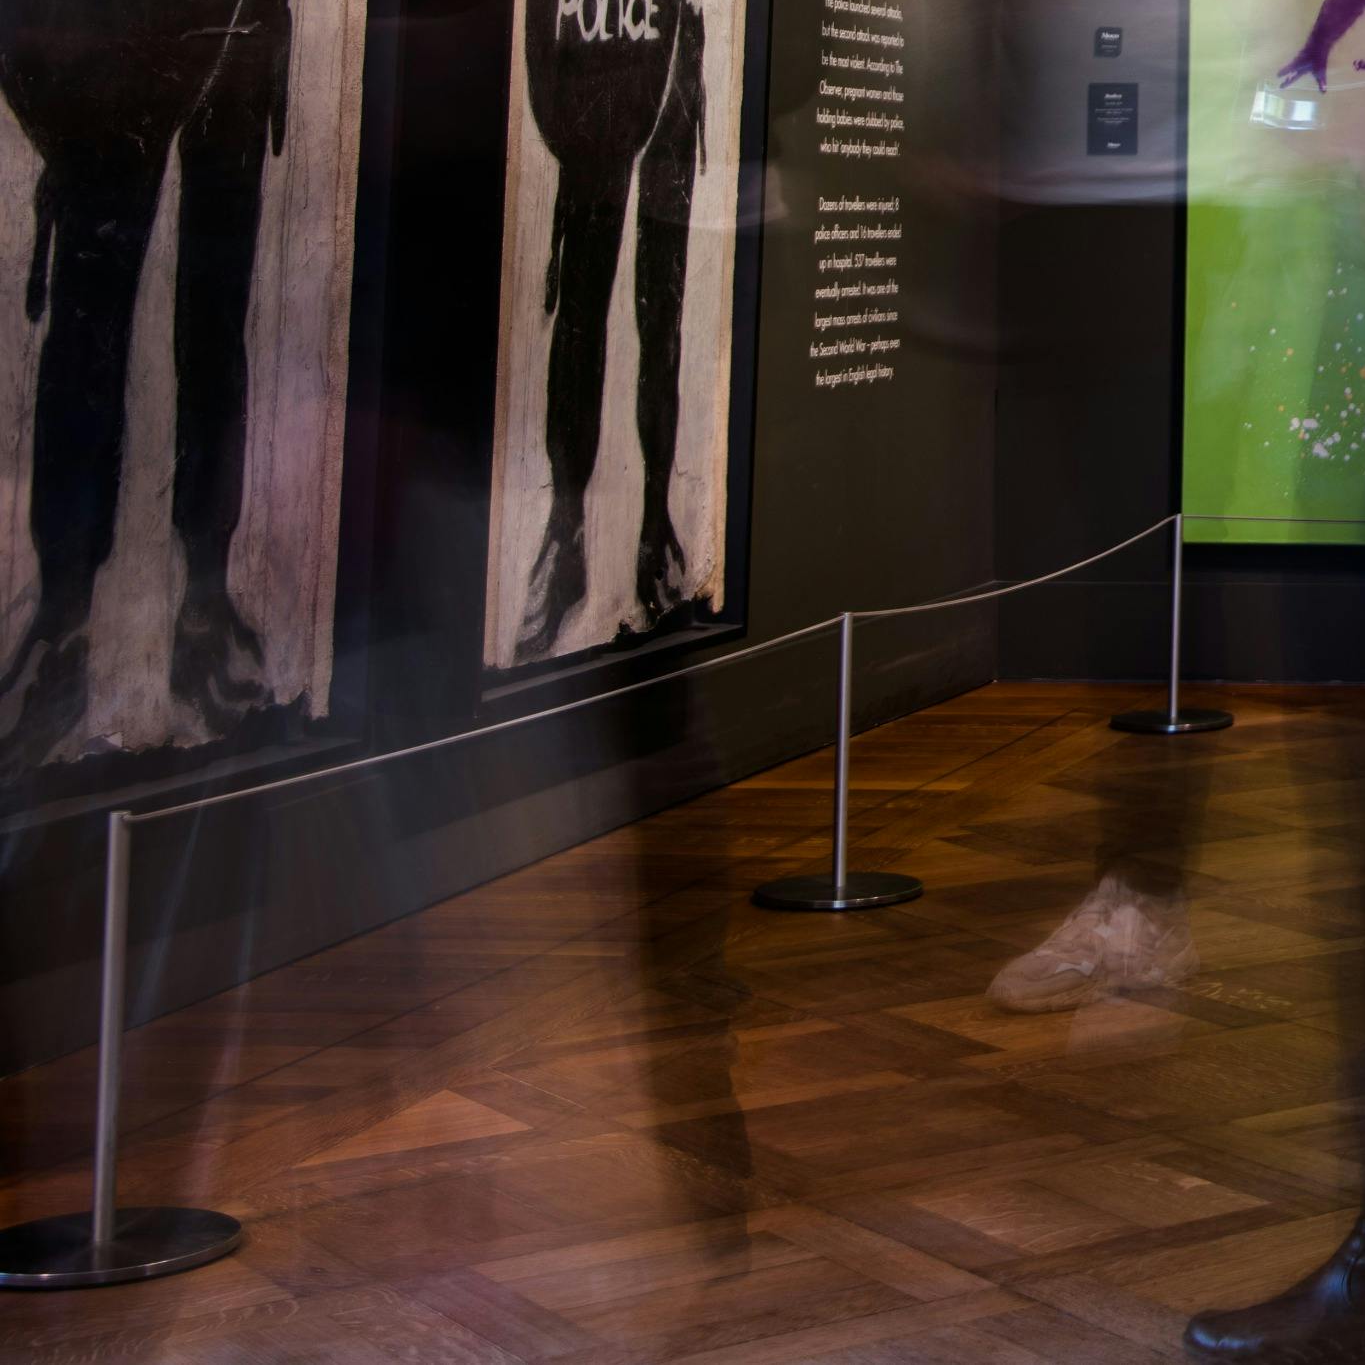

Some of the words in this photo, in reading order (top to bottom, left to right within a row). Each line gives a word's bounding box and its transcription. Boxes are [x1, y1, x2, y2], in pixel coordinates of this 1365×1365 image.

[870, 1, 887, 18] several
[822, 19, 831, 37] but
[830, 20, 839, 38] the
[839, 24, 857, 42] second
[856, 26, 870, 43] attack
[870, 33, 881, 44] was
[880, 31, 900, 50] reported
[822, 49, 829, 66] be
[829, 50, 838, 67] the
[837, 55, 850, 68] most
[866, 56, 890, 77] According
[890, 61, 896, 74] to
[895, 59, 904, 75] The
[844, 85, 866, 102] pregnant
[865, 89, 883, 100] women
[882, 85, 893, 101] and
[892, 85, 905, 103] those
[816, 106, 836, 129] holding
[836, 108, 853, 126] babies
[853, 116, 866, 127] were
[865, 110, 885, 128] clubbed
[820, 136, 832, 154] who
[862, 138, 873, 159] they
[872, 140, 886, 156] could
[819, 196, 839, 212] Dozens
[838, 194, 845, 212] of
[866, 201, 878, 212] were
[895, 196, 900, 212] 8
[814, 223, 831, 245] police
[831, 223, 849, 241] officers
[849, 223, 860, 240] and
[887, 223, 902, 240] ended
[819, 259, 827, 274] up
[826, 254, 833, 269] in
[885, 256, 898, 267] were
[815, 281, 841, 302] eventually
[866, 285, 877, 296] was
[876, 284, 887, 295] one
[885, 277, 893, 295] of
[891, 277, 900, 294] the
[814, 311, 833, 332] largest
[832, 315, 846, 326] mass
[846, 312, 863, 325] arrests
[862, 307, 869, 324] of
[868, 307, 887, 324] civilians
[886, 308, 899, 323] since
[810, 341, 819, 357] the
[819, 338, 839, 356] Second
[838, 337, 856, 354] World
[854, 338, 867, 353] War
[870, 334, 890, 355] perhaps
[889, 338, 901, 349] even
[816, 370, 825, 387] the
[825, 368, 843, 389] largest
[842, 368, 849, 383] in
[848, 364, 866, 386] English
[865, 363, 878, 383] legal
